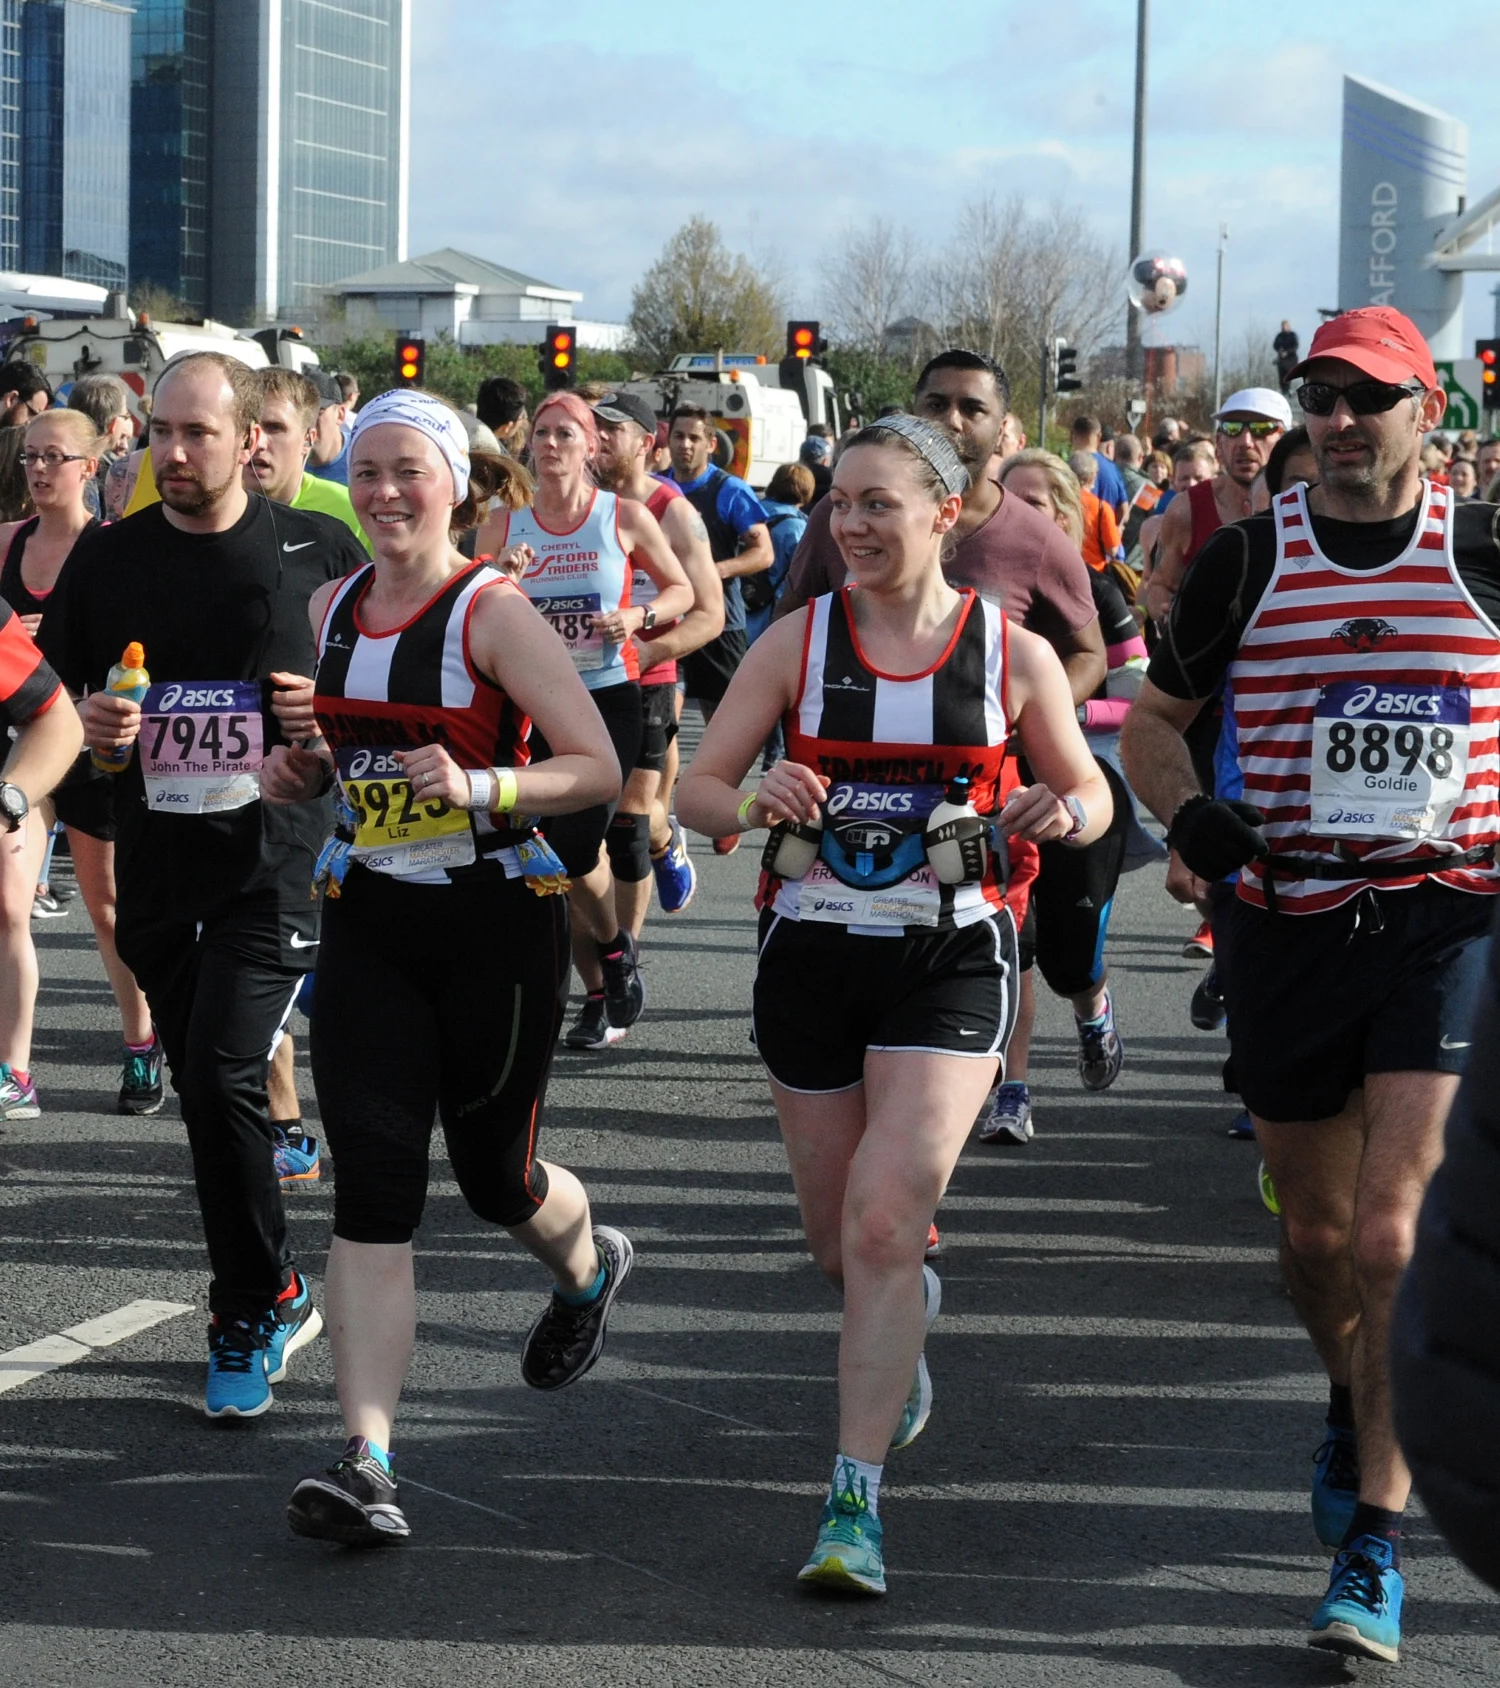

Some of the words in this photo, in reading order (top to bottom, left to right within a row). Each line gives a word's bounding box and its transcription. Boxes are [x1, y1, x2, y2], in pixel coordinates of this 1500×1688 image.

[1369, 182, 1398, 306] AFFORD
[541, 542, 581, 552] CHERYL
[530, 576, 565, 584] RUNNING
[567, 573, 588, 581] CLUB
[148, 715, 250, 760] 7945
[1326, 721, 1454, 779] 8898
[150, 761, 180, 773] John
[184, 761, 208, 772] The
[213, 760, 251, 772] Pirate
[1364, 776, 1418, 792] Goldie
[388, 827, 410, 839] Liz
[410, 841, 443, 851] GREATER
[408, 856, 451, 867] MARATHON
[873, 896, 908, 904] GREATER
[869, 911, 915, 919] MARATHON
